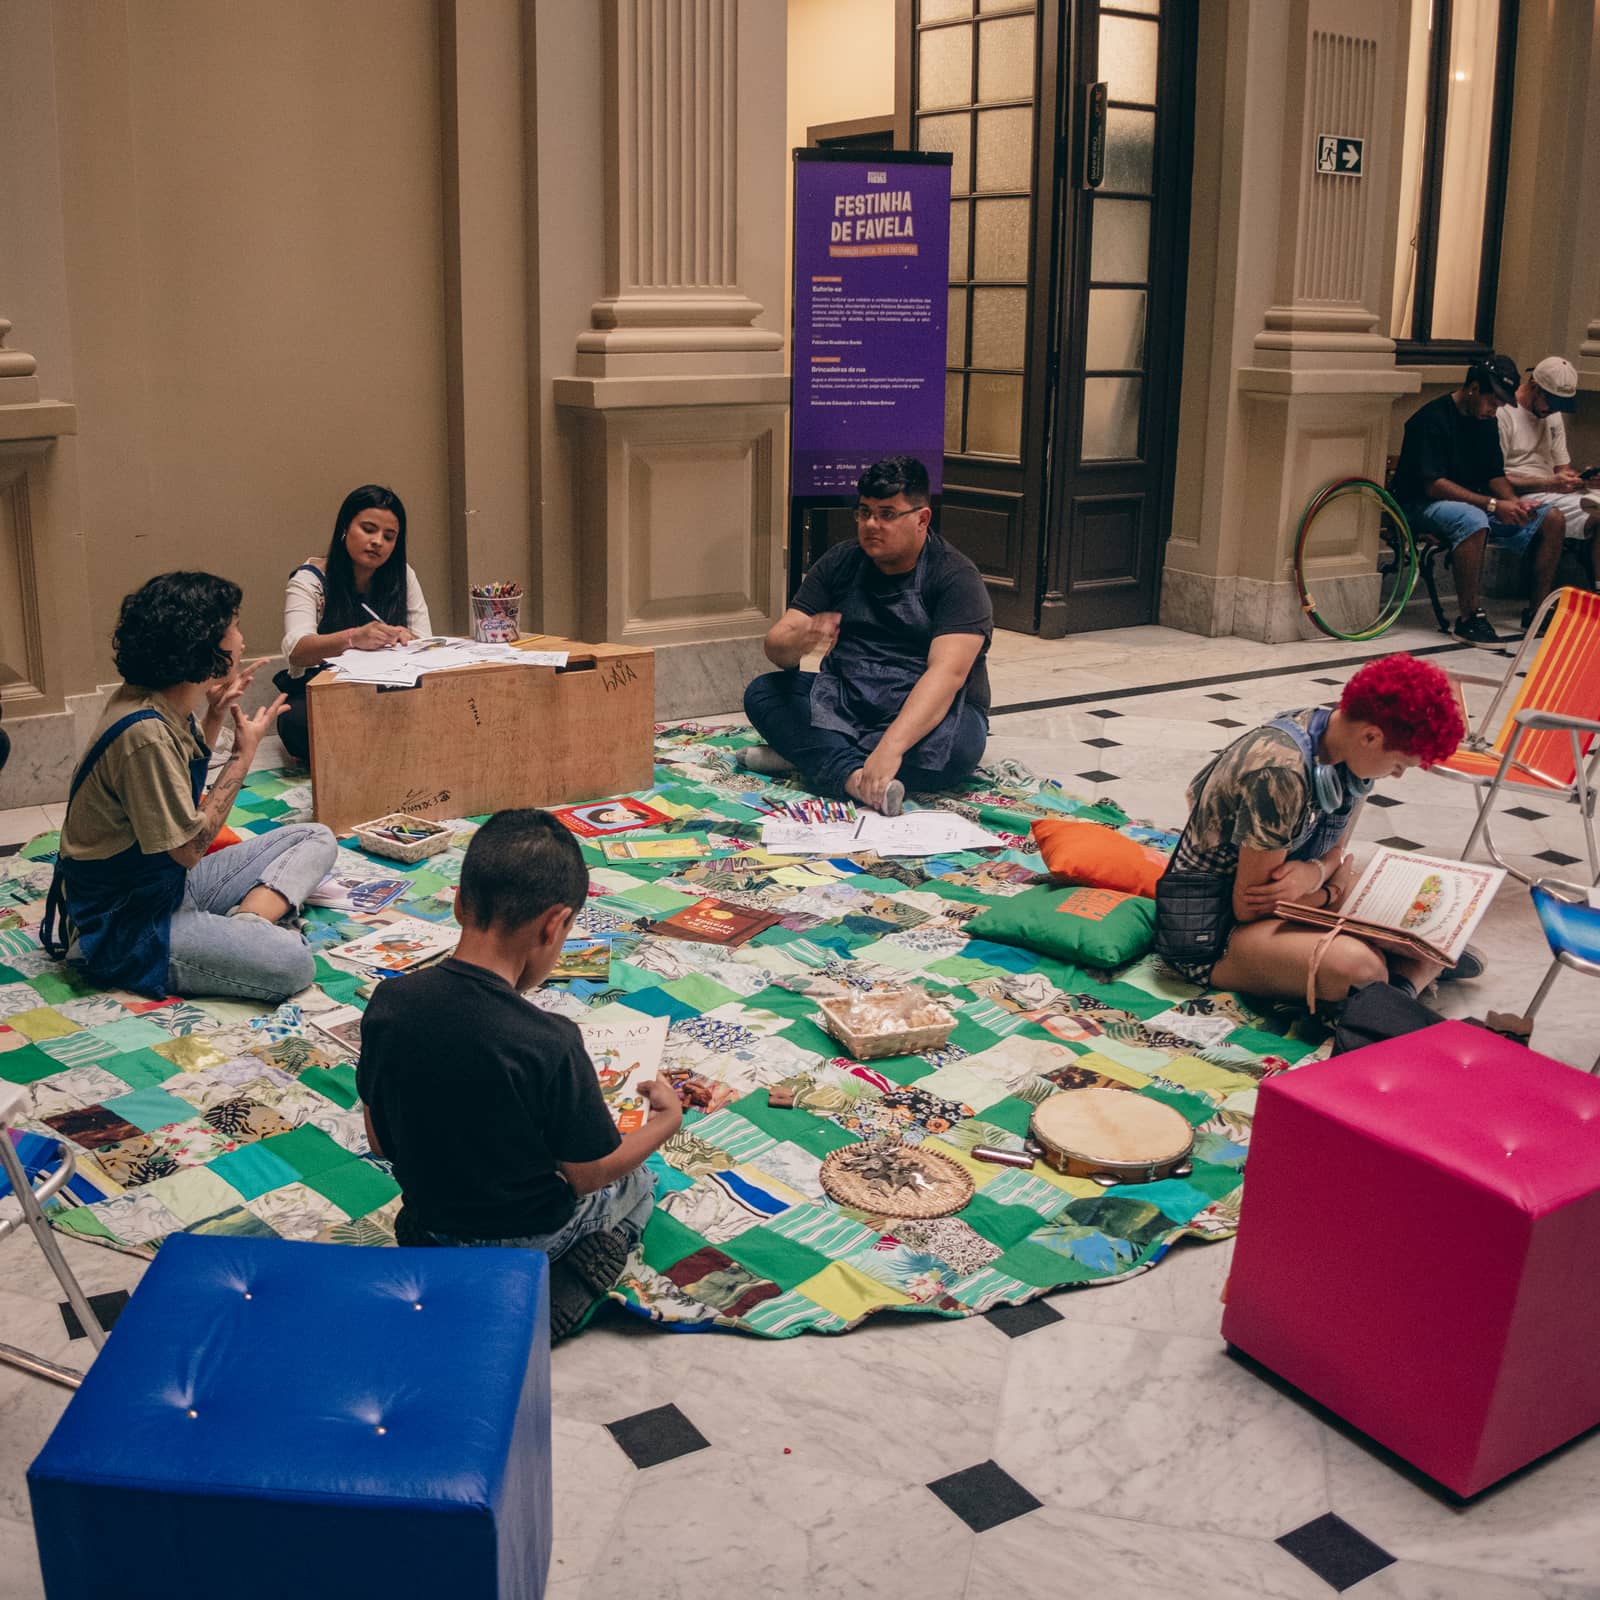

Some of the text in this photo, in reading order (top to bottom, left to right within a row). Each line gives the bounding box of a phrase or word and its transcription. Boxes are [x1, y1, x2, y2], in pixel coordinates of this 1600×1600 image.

[835, 191, 912, 217] FESTINHA
[831, 216, 914, 242] DE FAVELA
[586, 1027, 614, 1039] STA
